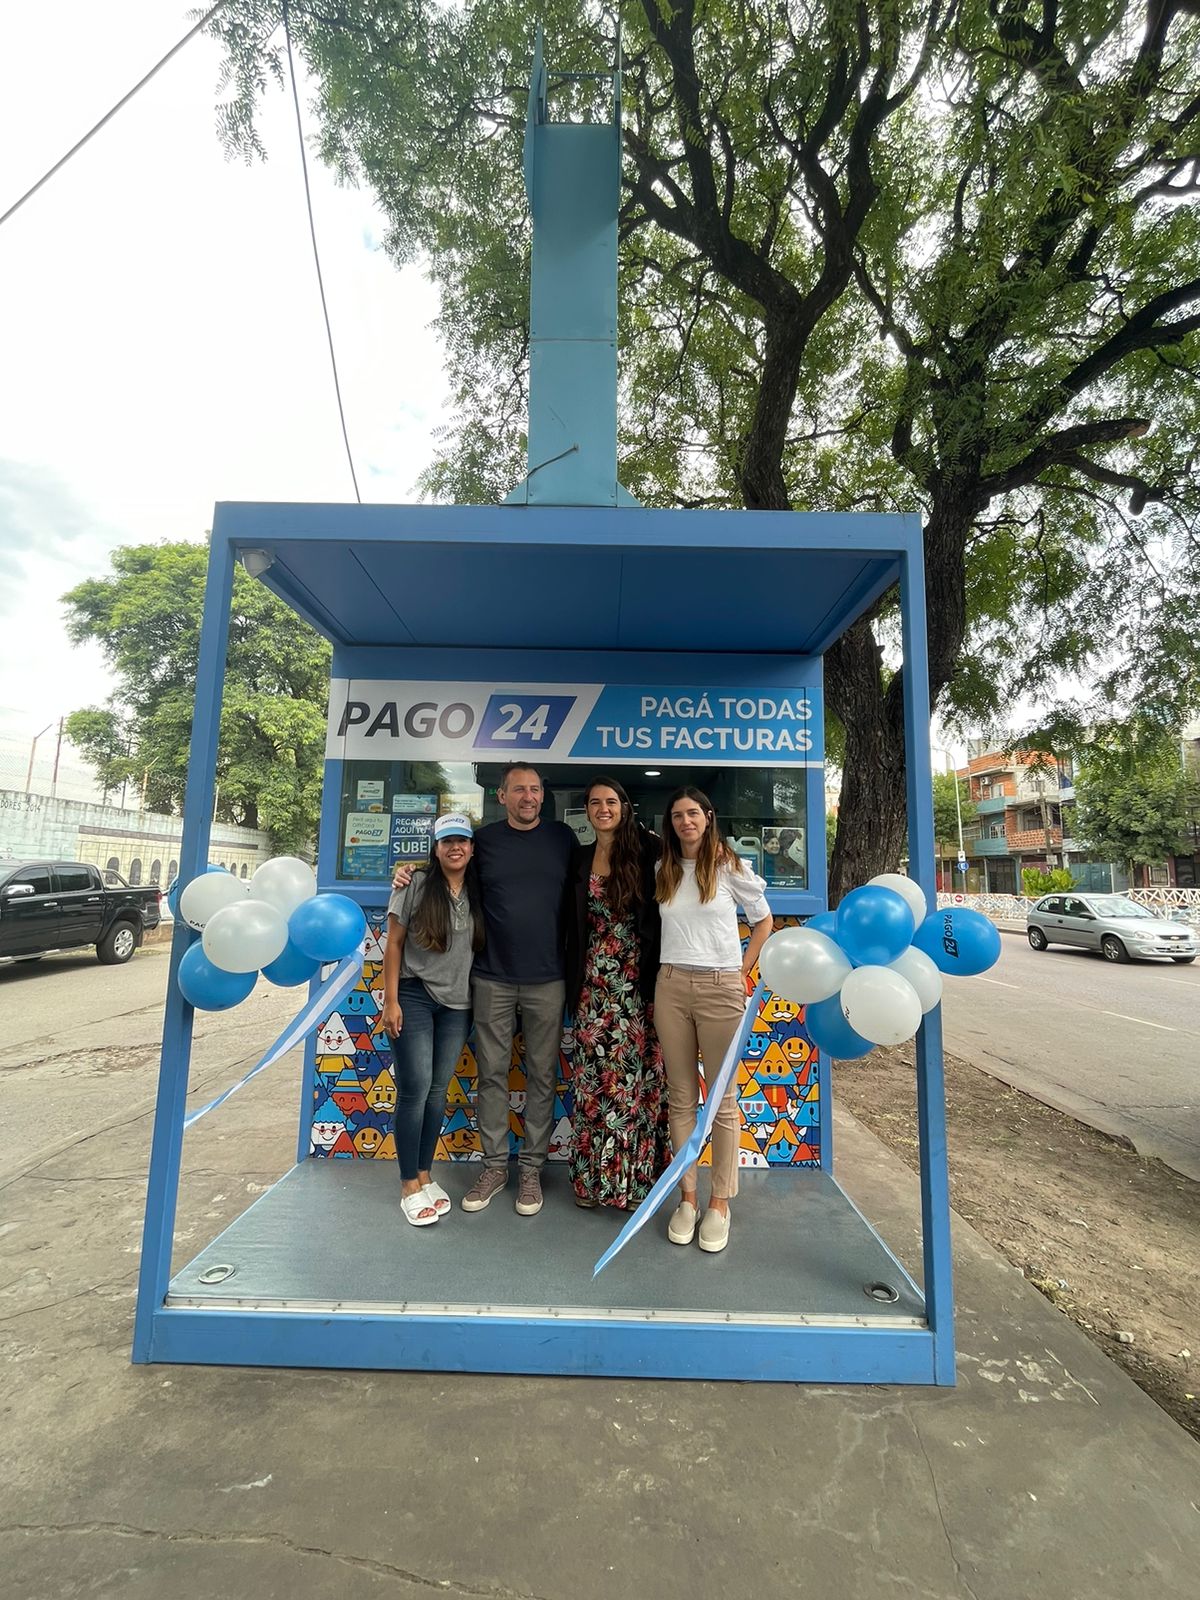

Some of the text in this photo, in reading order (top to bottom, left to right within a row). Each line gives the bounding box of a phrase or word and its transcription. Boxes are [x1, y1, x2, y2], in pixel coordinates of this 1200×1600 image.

[641, 692, 813, 720] PAGÁ TODAS
[337, 701, 551, 741] PAGO 24
[596, 726, 813, 751] TUS FACTURAS
[393, 841, 428, 853] SUBE
[944, 915, 953, 937] PAGO
